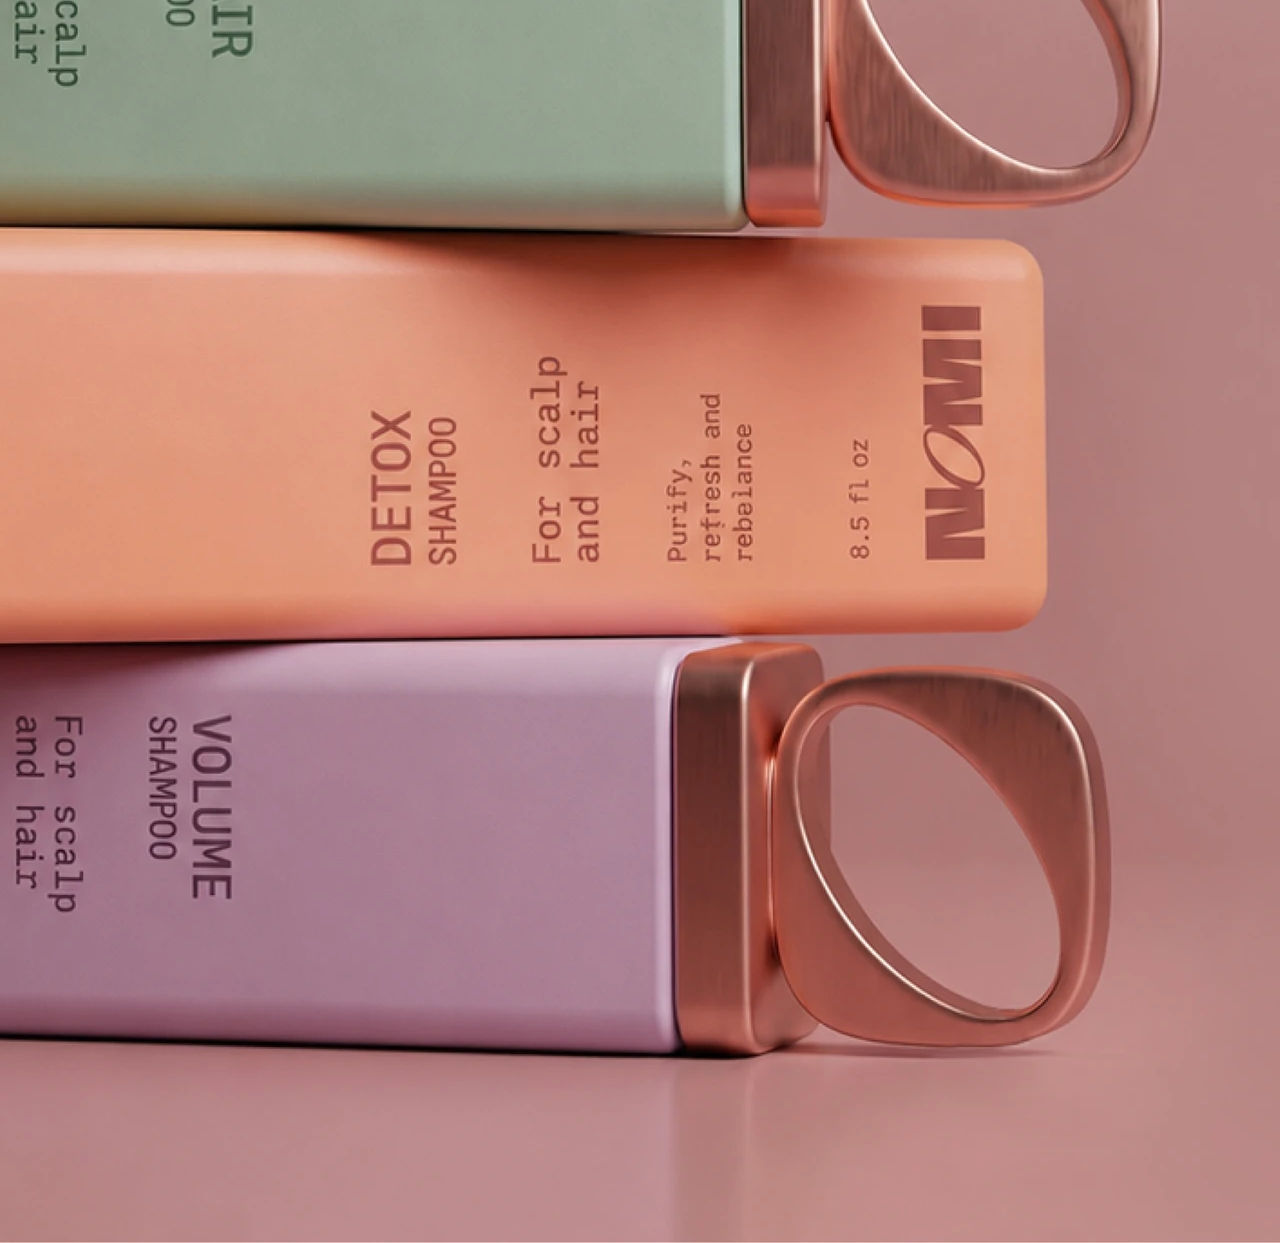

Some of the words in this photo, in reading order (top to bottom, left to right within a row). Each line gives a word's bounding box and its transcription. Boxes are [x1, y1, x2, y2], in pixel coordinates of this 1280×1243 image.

[529, 356, 568, 469] scalp
[569, 380, 600, 469] hair
[699, 393, 721, 440] and
[852, 439, 869, 468] oz
[920, 304, 986, 561] NOMI
[370, 410, 412, 566] DETOX
[427, 417, 457, 565] SHAMPOO
[531, 496, 562, 563] For
[569, 496, 600, 563] and
[665, 459, 694, 562] Purify,
[848, 479, 870, 504] fl
[849, 516, 870, 560] 8.5
[15, 715, 46, 778] and
[54, 715, 83, 779] For
[148, 716, 178, 860] SHAMPOO
[15, 805, 46, 890] hair
[191, 715, 233, 900] VOLUME
[47, 805, 84, 913] scalp
